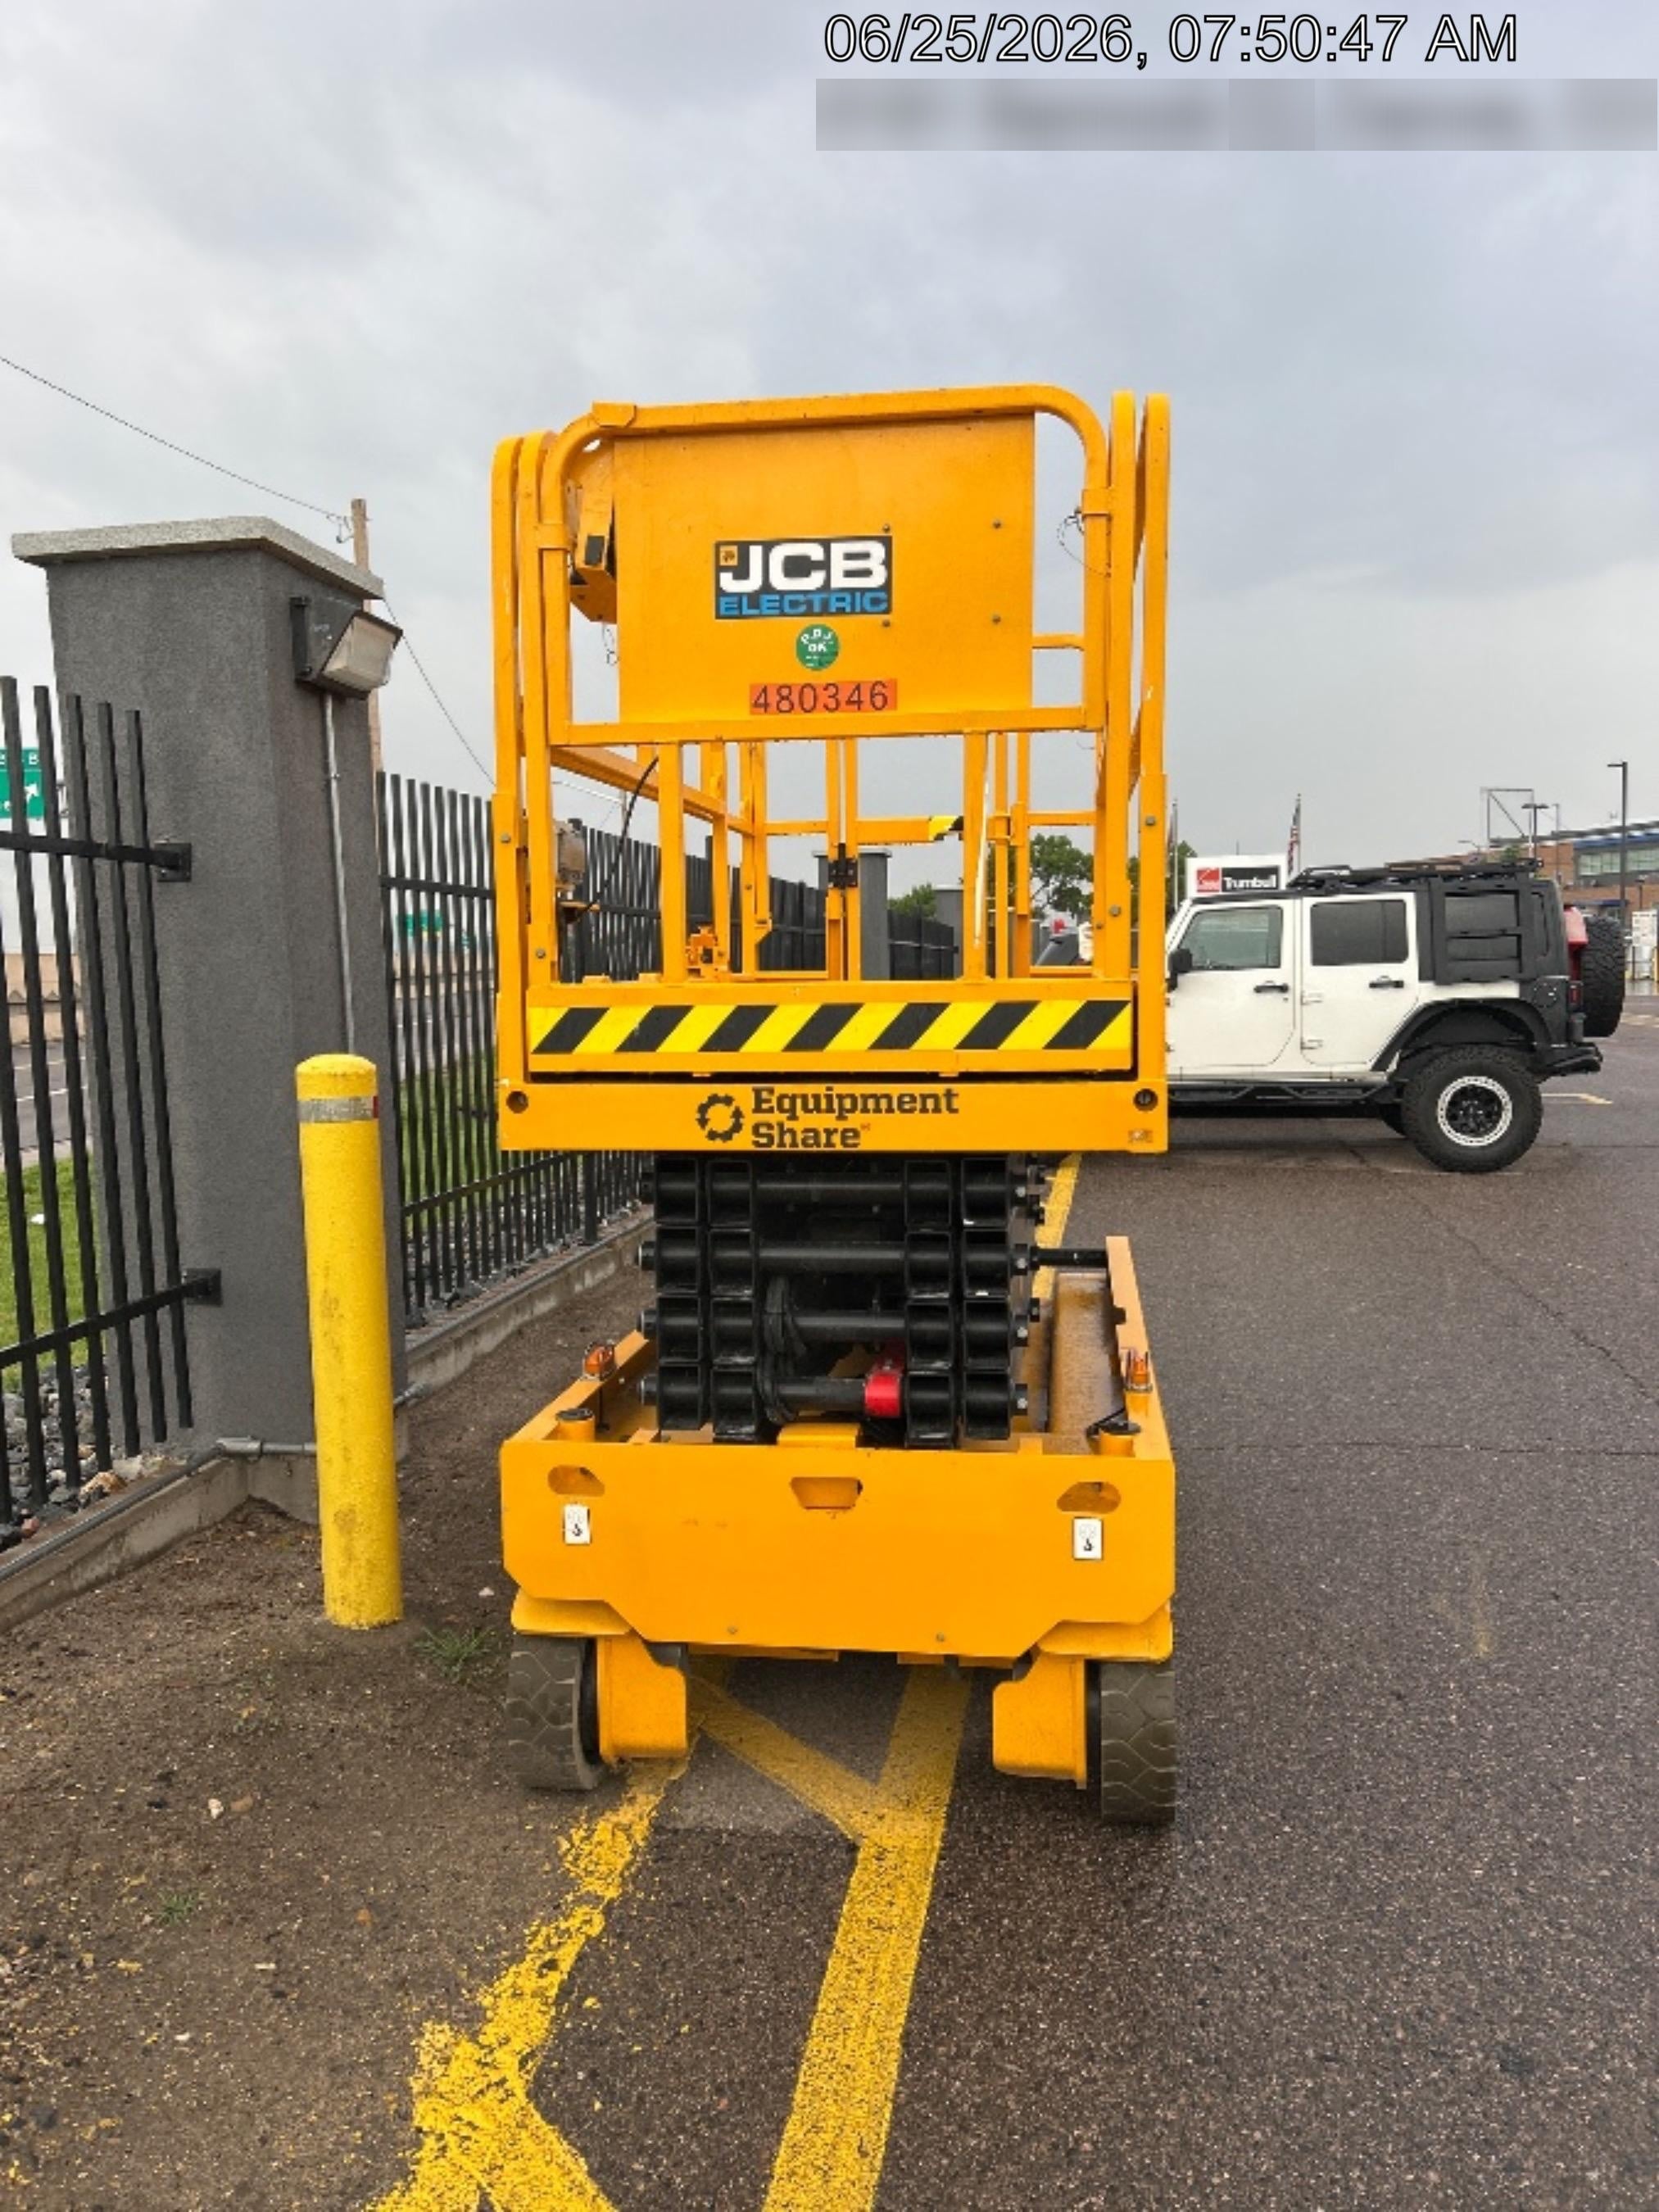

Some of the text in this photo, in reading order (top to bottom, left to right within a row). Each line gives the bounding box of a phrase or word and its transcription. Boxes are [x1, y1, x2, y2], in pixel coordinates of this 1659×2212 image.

[719, 540, 887, 593] JCB
[719, 592, 888, 616] ELECTRIC
[752, 681, 888, 714] 480346
[1223, 874, 1277, 891] Trumbull
[751, 1086, 959, 1121] Equipment
[751, 1122, 861, 1148] Share
